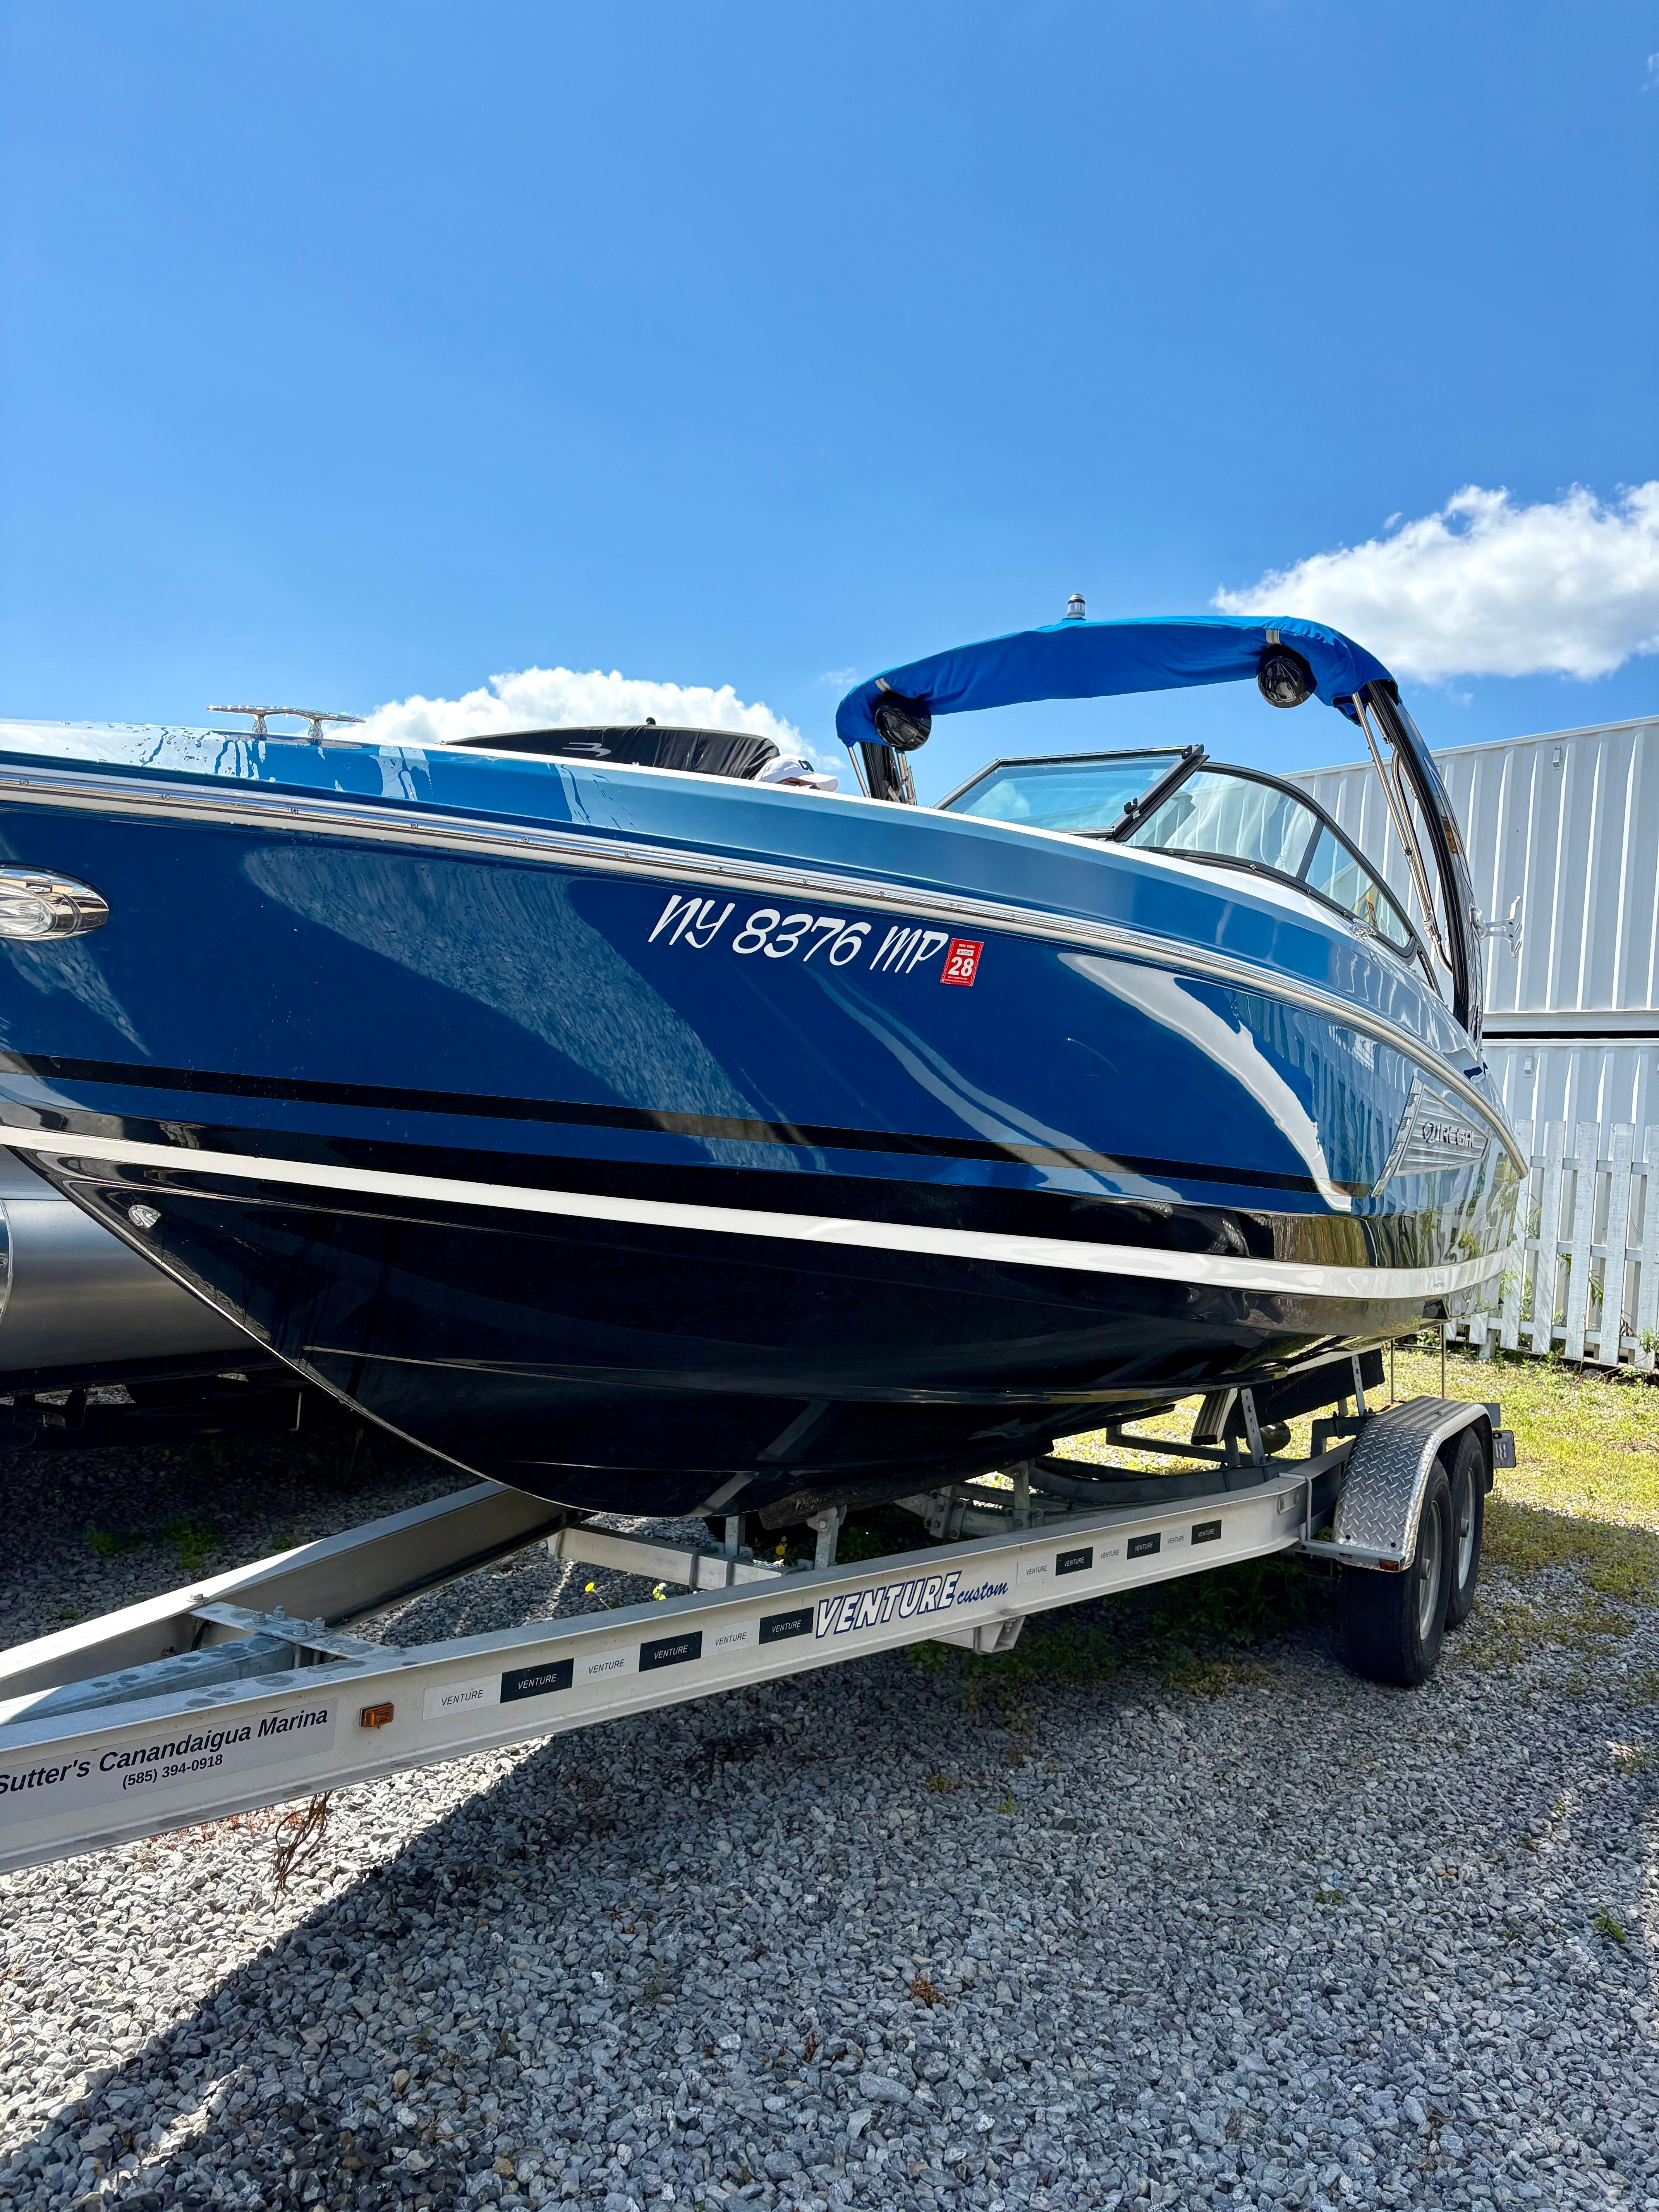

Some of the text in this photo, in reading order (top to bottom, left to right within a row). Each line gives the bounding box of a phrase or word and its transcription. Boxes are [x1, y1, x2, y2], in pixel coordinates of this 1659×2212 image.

[648, 895, 949, 974] NY 8376 MP
[947, 957, 974, 977] 28
[1025, 1528, 1216, 1575] VENTURE VENTURE VENTURE VENTURE VENTURE VENTURE
[815, 1570, 1008, 1639] VENTURE custom
[442, 1620, 802, 1706] VENTURE VENTURE VENTURE VENTURE VENTURE VENTURE
[0, 1710, 328, 1794] Sutter's Canandaigua Marina
[123, 1754, 223, 1790] (585) 394-0918
